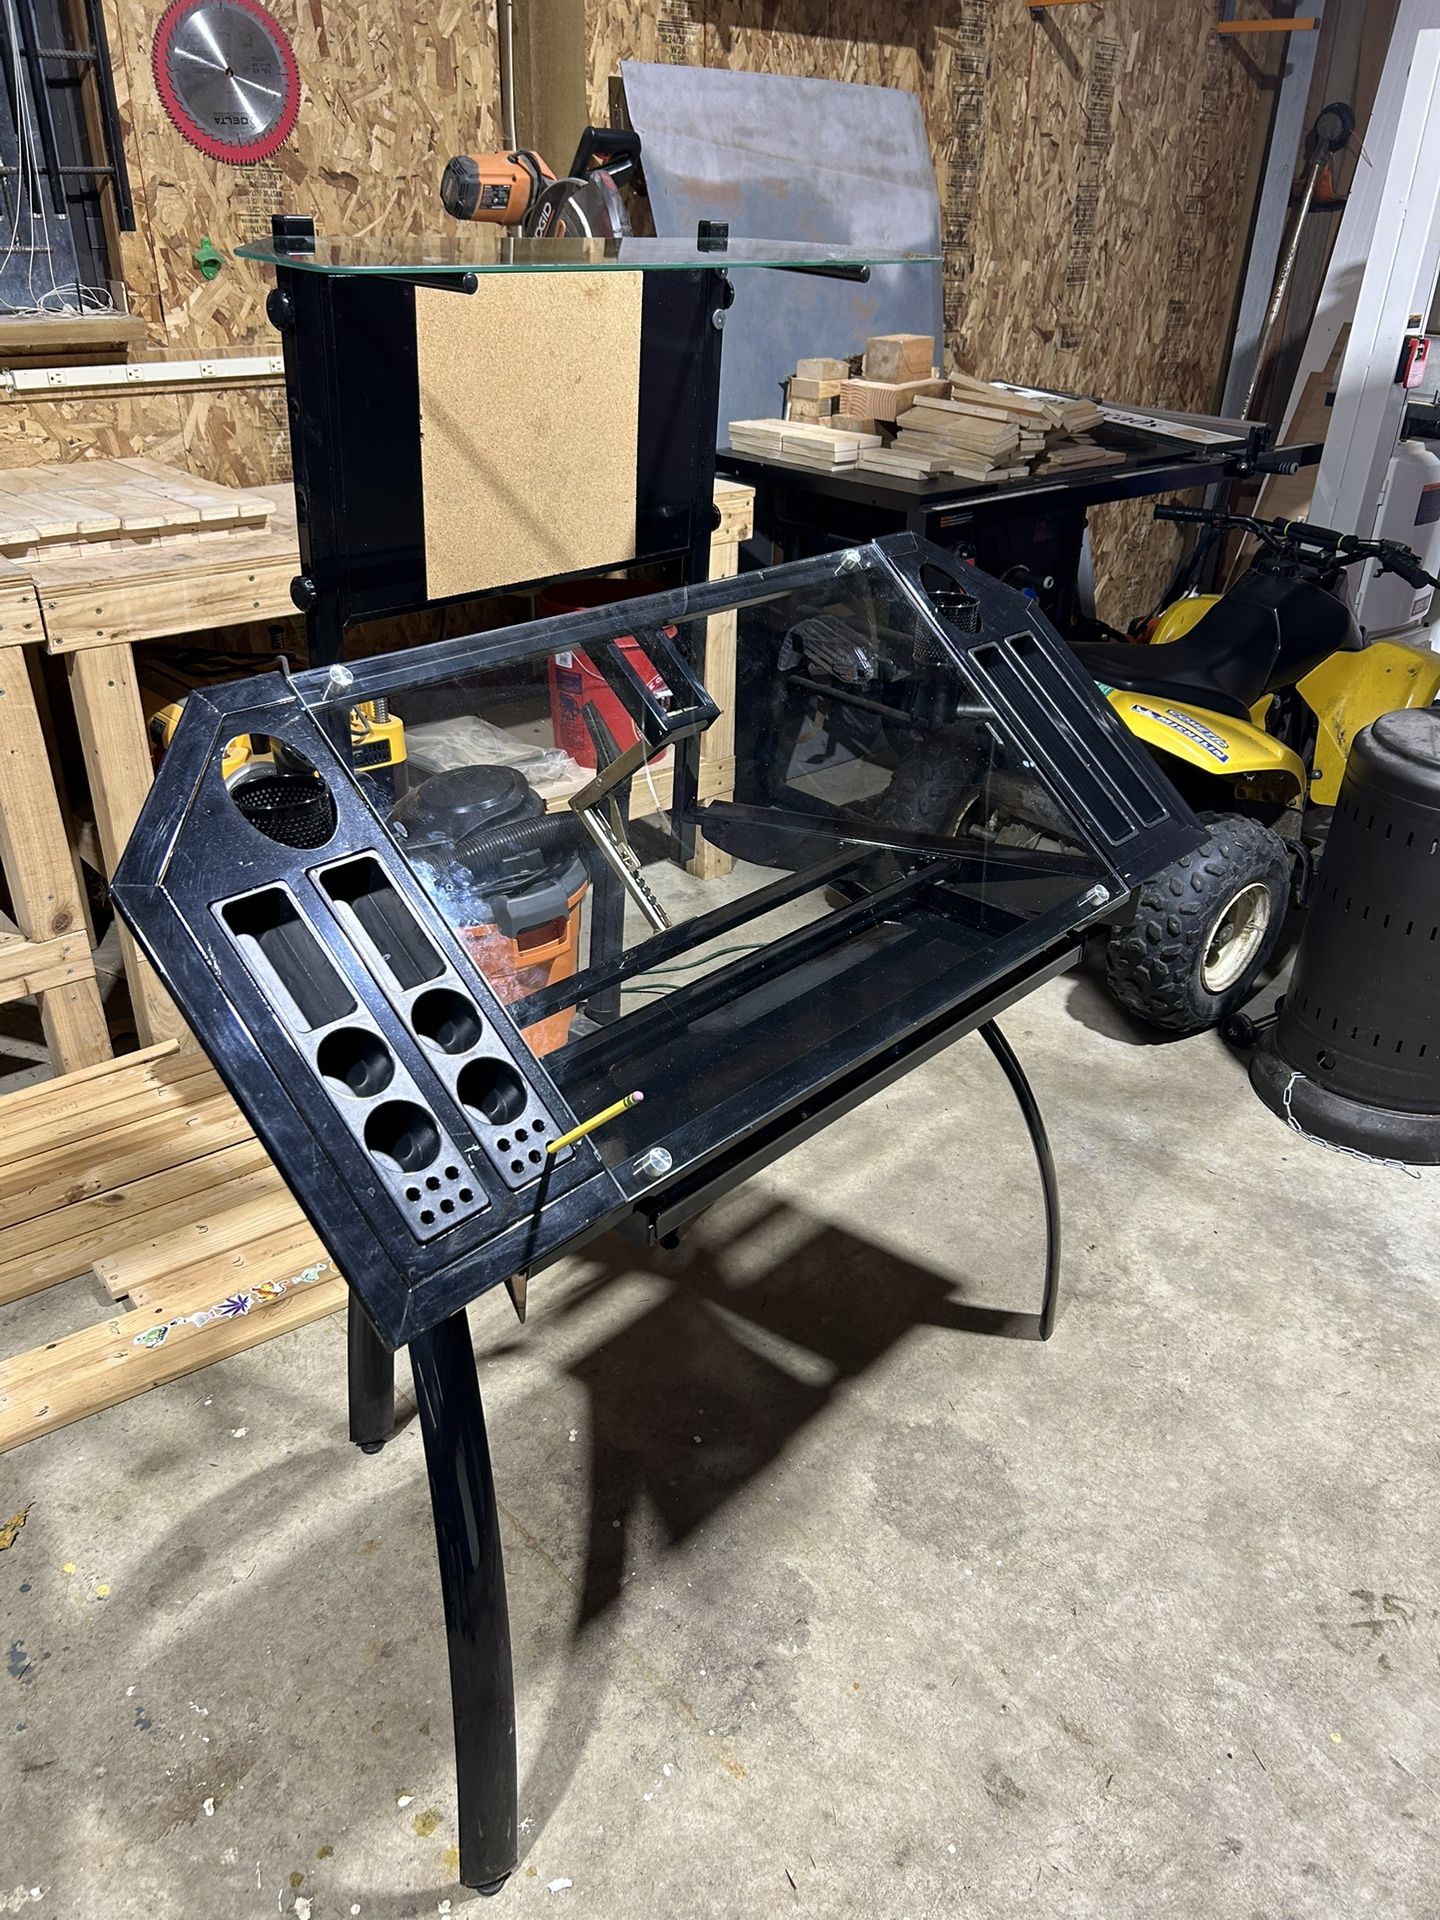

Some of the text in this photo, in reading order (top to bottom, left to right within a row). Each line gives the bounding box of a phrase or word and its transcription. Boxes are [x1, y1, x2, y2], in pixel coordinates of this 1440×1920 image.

[213, 117, 249, 125] DELTA
[534, 201, 552, 239] DGID
[1157, 715, 1227, 759] MICHELIN
